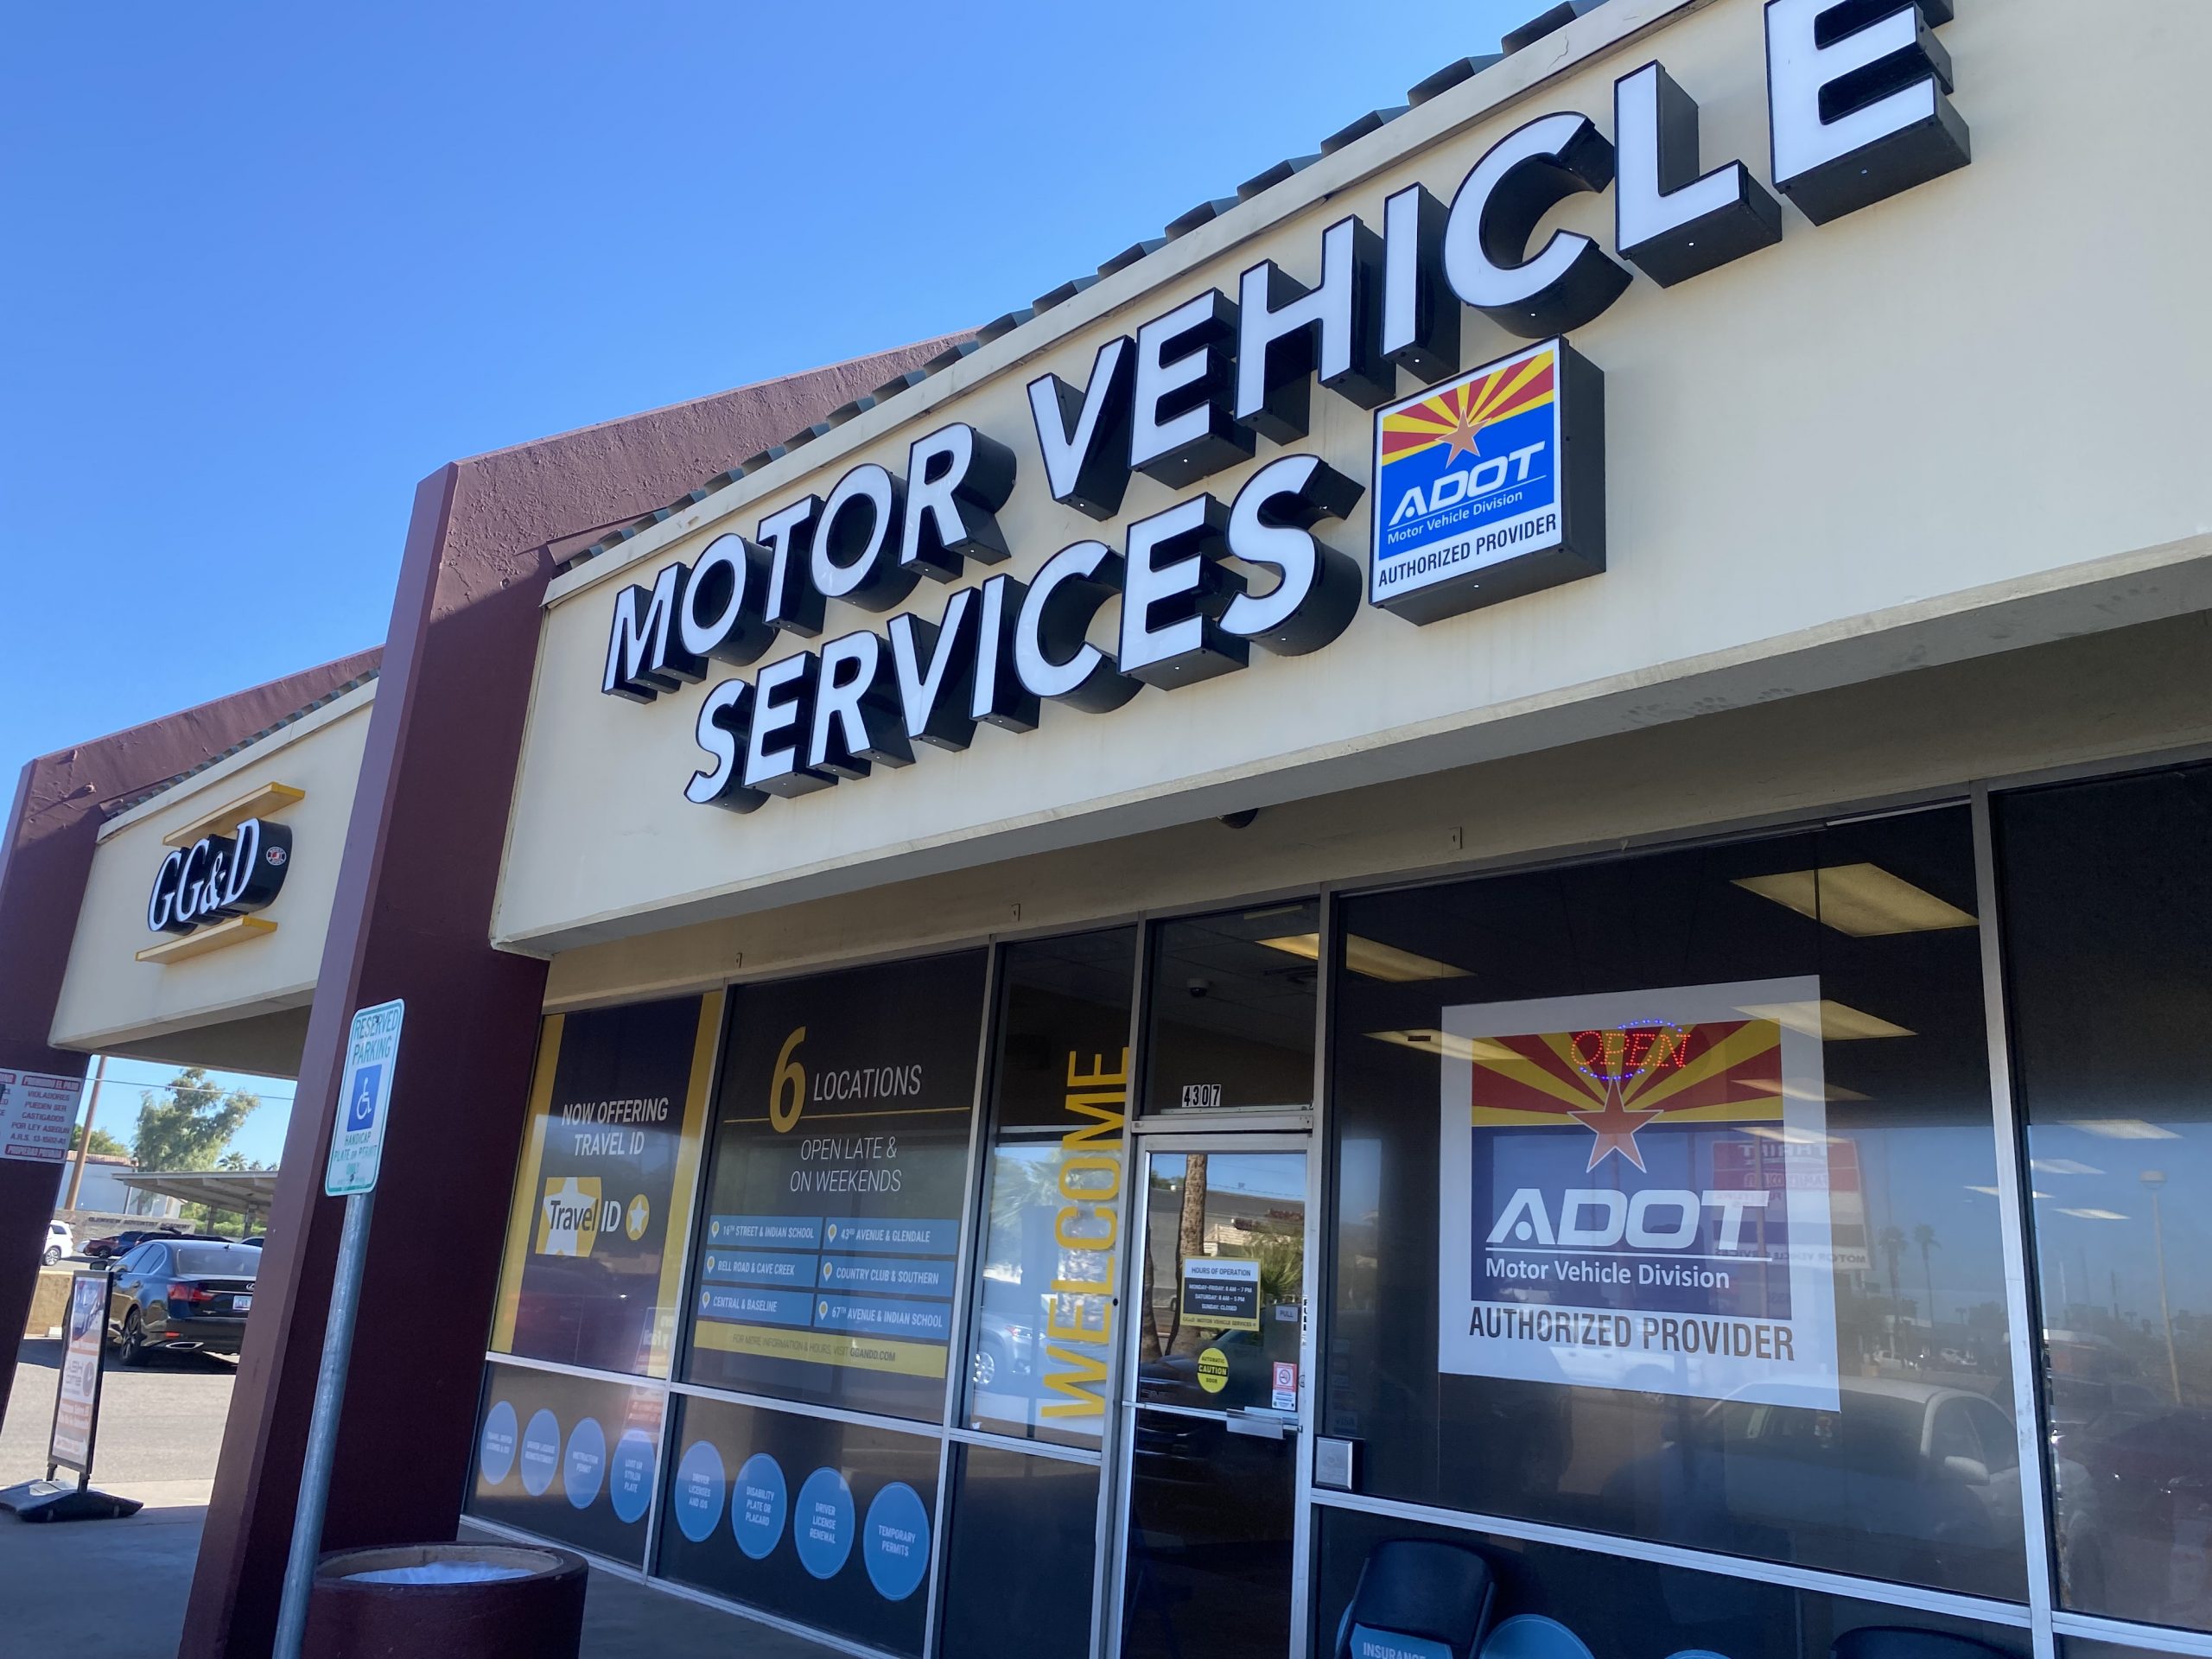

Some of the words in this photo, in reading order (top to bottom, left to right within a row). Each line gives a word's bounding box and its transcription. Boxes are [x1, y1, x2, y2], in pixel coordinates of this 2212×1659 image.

[601, 422, 973, 695] MOTOR
[1027, 0, 1940, 501] VEHICLE
[1389, 441, 1546, 526] ADOT
[1387, 524, 1424, 545] Motor
[1427, 508, 1469, 531] Vehicle
[1473, 491, 1523, 516] Division
[1378, 542, 1471, 587] AUTHORIZED
[1476, 513, 1556, 555] PROVIDER
[684, 454, 1325, 805] SERVICES
[148, 817, 261, 932] GG&D
[353, 1008, 399, 1040] RESERVED
[353, 1036, 392, 1065] PARKING
[1570, 1031, 1691, 1068] OPEN
[770, 1026, 806, 1133] 6
[813, 1065, 922, 1102] LOCATIONS
[1184, 1085, 1220, 1106] 4307
[562, 1102, 596, 1126] NOW
[597, 1096, 669, 1124] OFFERING
[28, 1122, 41, 1131] LEY
[344, 1131, 372, 1147] HANDICAP
[575, 1133, 626, 1156] TRAVEL
[629, 1131, 645, 1155] ID
[800, 1138, 842, 1160] OPEN
[844, 1136, 884, 1160] LATE
[886, 1135, 898, 1159] &
[790, 1170, 812, 1192] ON
[816, 1168, 903, 1192] WEEKENDS
[550, 1198, 599, 1231] Travel
[601, 1200, 622, 1232] ID
[1484, 1188, 1770, 1252] ADOT
[735, 1225, 758, 1237] STREET
[760, 1226, 765, 1237] &
[765, 1227, 787, 1238] INDIAN
[787, 1227, 815, 1239] SCHOOL
[855, 1229, 885, 1242] AVENUE
[885, 1230, 891, 1242] &
[892, 1230, 931, 1243] GLENDALE
[1040, 1046, 1129, 1418] WELCOME
[717, 1260, 732, 1272] BELL
[733, 1261, 751, 1273] ROAD
[751, 1262, 756, 1273] &
[756, 1262, 774, 1274] CAVE
[774, 1263, 795, 1276] CREEK
[836, 1267, 869, 1281] COUNTRY
[870, 1268, 890, 1282] CLUB
[891, 1270, 897, 1282] &
[897, 1270, 939, 1285] SOUTHERN
[1485, 1256, 1549, 1281] Motor
[1554, 1259, 1632, 1284] Vehicle
[1638, 1262, 1730, 1289] Division
[713, 1296, 740, 1310] CENTRAL
[741, 1298, 746, 1310] &
[747, 1298, 778, 1313] BASELINE
[831, 1306, 847, 1319] 67TH
[847, 1307, 876, 1322] AVENUE
[876, 1310, 883, 1322] &
[883, 1311, 911, 1325] INDIAN
[912, 1313, 943, 1328] SCHOOL
[1469, 1306, 1632, 1348] AUTHORIZED
[1643, 1317, 1795, 1361] PROVIDER
[733, 1333, 745, 1344] FOR
[745, 1335, 761, 1346] MORE
[762, 1336, 803, 1351] INFORMATION
[834, 1345, 849, 1357] VISIT
[849, 1347, 896, 1363] GGANDD.COM
[1198, 1364, 1227, 1376] CAUTION
[624, 1470, 641, 1481] STOLEN
[691, 1472, 710, 1484] DRIVER
[624, 1481, 638, 1493] PLATE
[746, 1485, 775, 1502] DISABILITY
[689, 1497, 699, 1507] AND
[747, 1498, 763, 1512] PLATE
[763, 1503, 772, 1513] OR
[815, 1502, 836, 1516] DRIVER
[745, 1511, 770, 1526] PLACARD
[812, 1515, 836, 1530] LICENSE
[809, 1528, 836, 1544] RENEWAL
[878, 1524, 916, 1544] TEMPORARY
[881, 1540, 910, 1557] PERMITS
[1363, 1642, 1427, 1659] INSURAN
